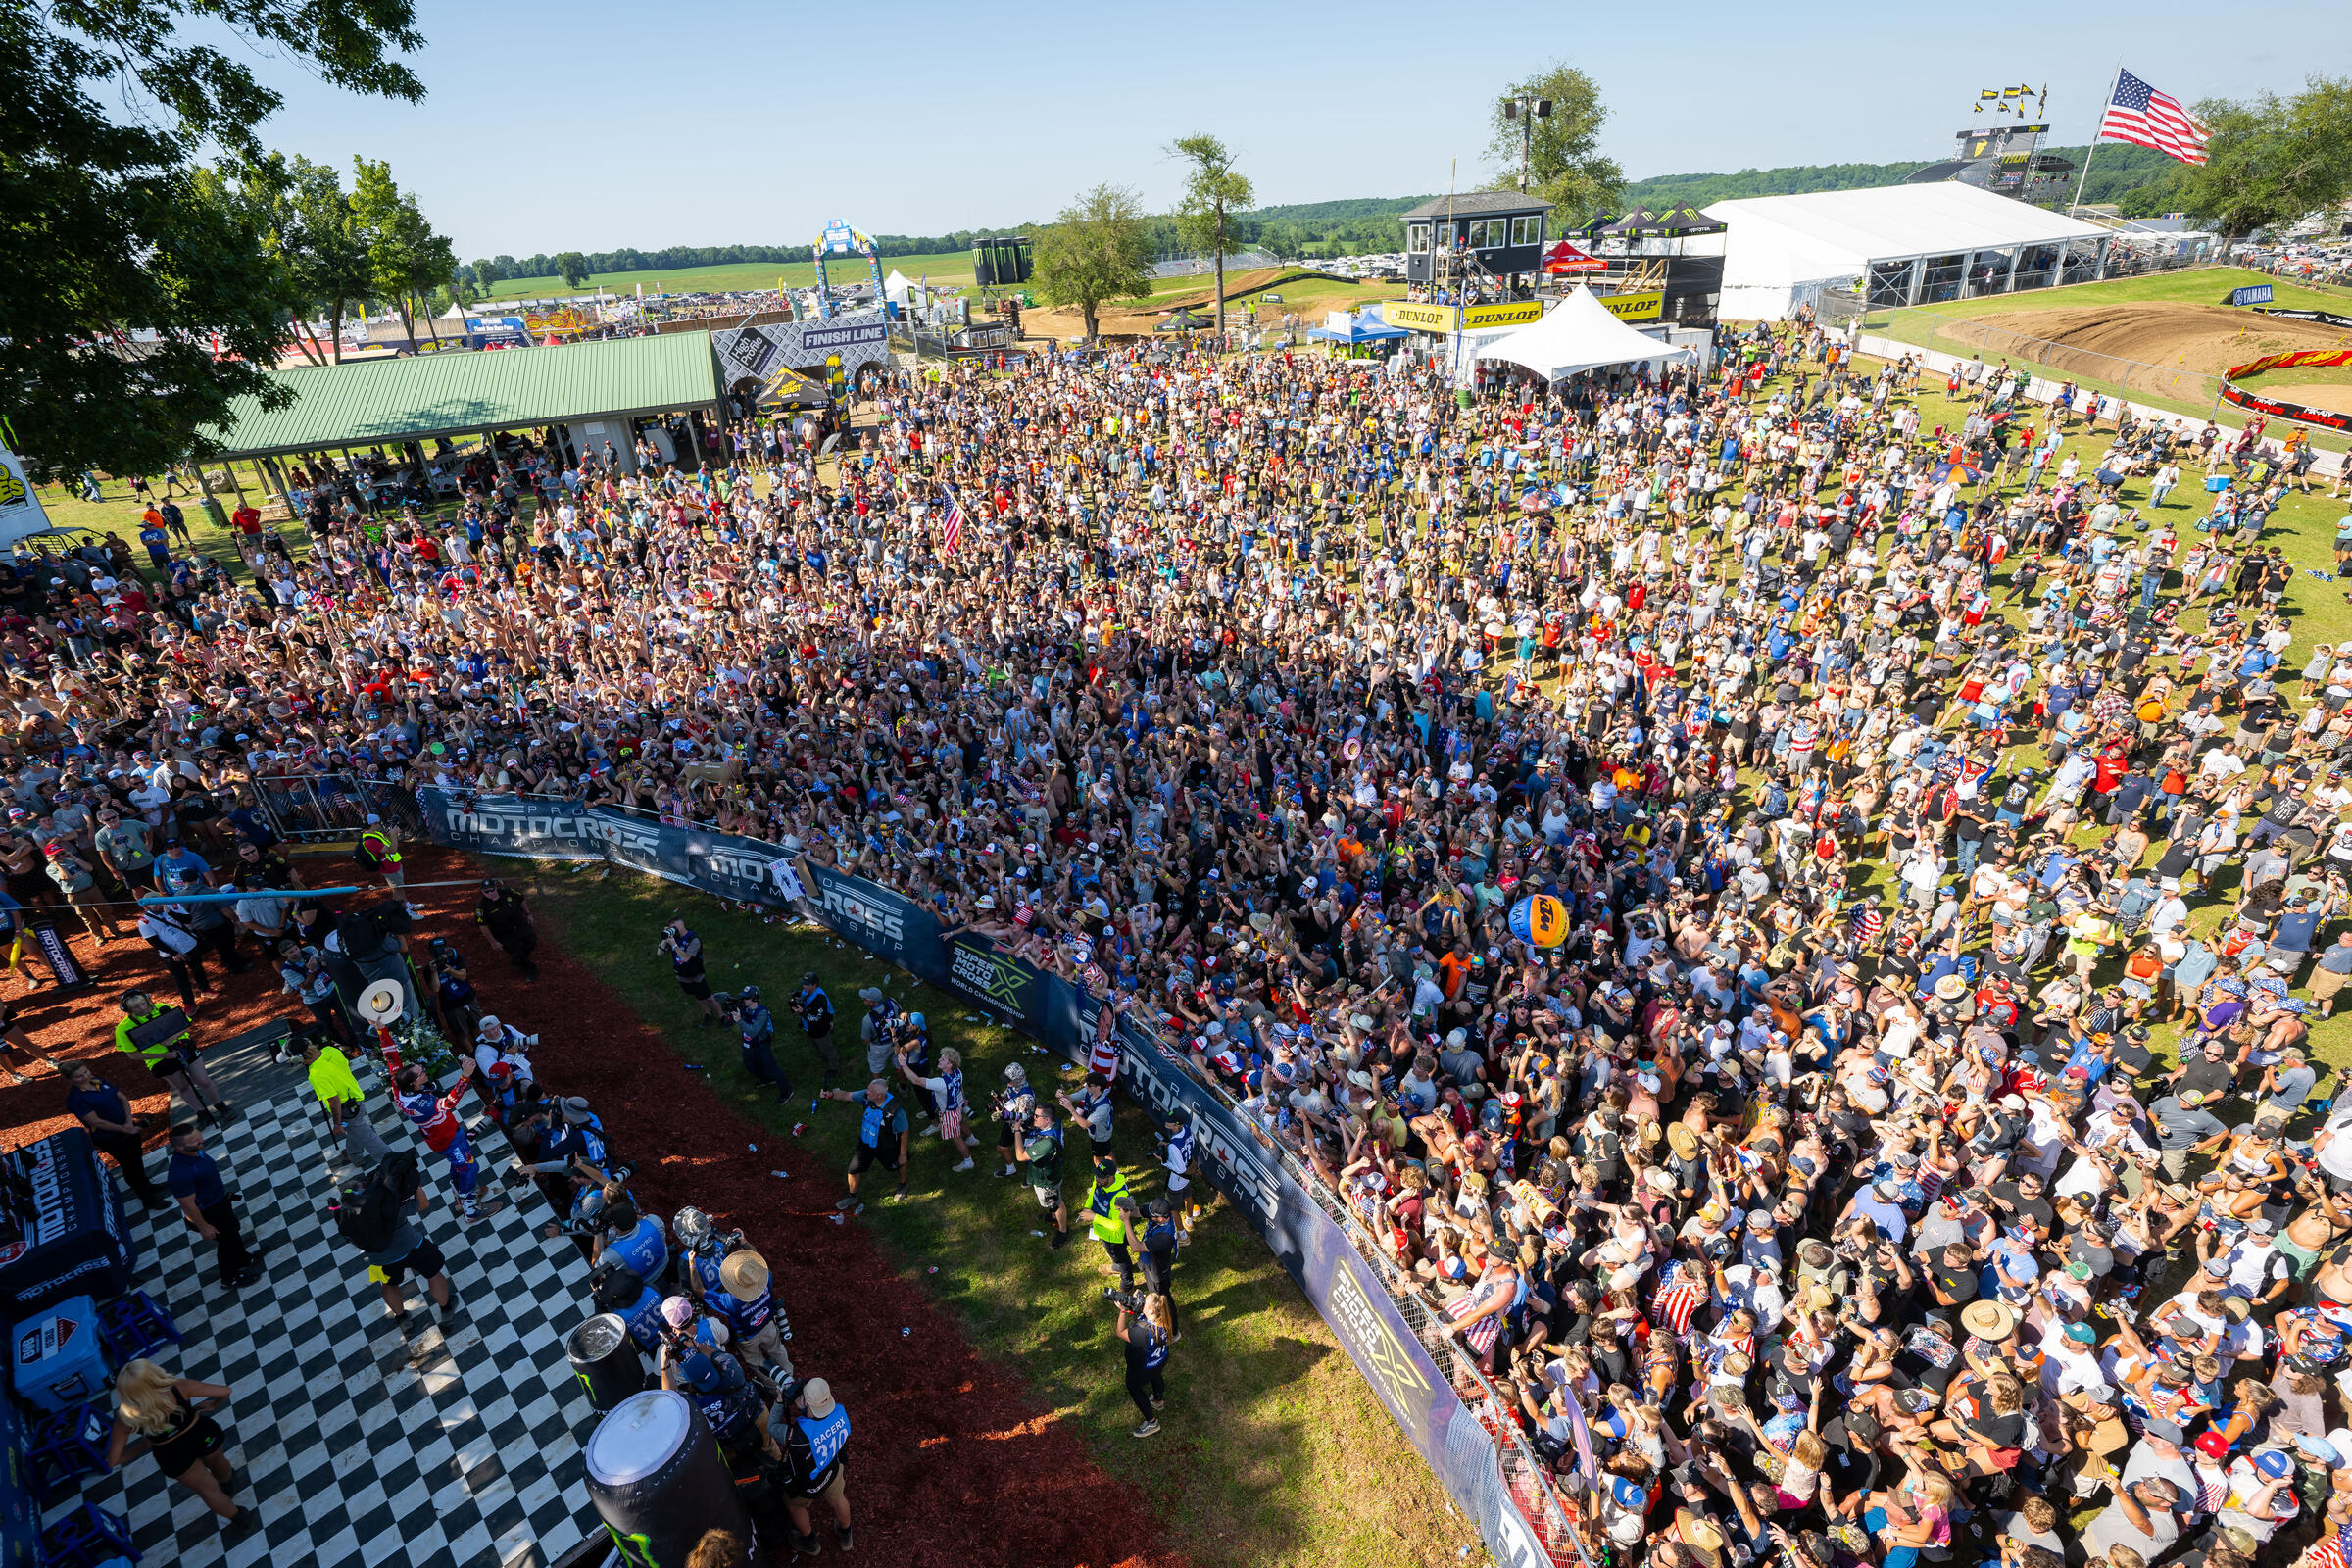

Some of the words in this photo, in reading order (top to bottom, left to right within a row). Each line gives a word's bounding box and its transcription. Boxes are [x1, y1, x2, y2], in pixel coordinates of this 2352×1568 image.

[2243, 286, 2272, 304] YAMAHA
[1398, 310, 1443, 324] DUNLOP
[1471, 310, 1539, 324] DUNLOP
[731, 336, 751, 361] High
[741, 336, 763, 366] Profile
[805, 330, 852, 347] FINISH
[853, 326, 883, 341] LINE
[527, 806, 584, 816] PRO
[451, 832, 660, 863] CHAMPIONSHI
[1538, 896, 1554, 932] KTM
[40, 929, 75, 984] MOTOCROSS
[954, 947, 996, 973] SUPER
[956, 956, 993, 980] MOTO
[952, 964, 992, 990] CROSS
[951, 977, 973, 994] WORLD
[974, 990, 1025, 1020] CHAMPIONSHIP
[24, 1139, 67, 1246] MOTOCROSS
[51, 1134, 78, 1232] CHAMPIONSHIP
[642, 1249, 655, 1267] 3
[15, 1258, 112, 1302] MOTOCROSS
[643, 1295, 660, 1313] MEDIA
[1338, 1268, 1382, 1336] SUPER
[1338, 1284, 1379, 1347] MOTO
[634, 1304, 664, 1340] 319
[1332, 1290, 1376, 1354] CROSS
[1330, 1306, 1356, 1346] WORLD
[1355, 1343, 1417, 1431] CHAMPIONSHIP
[813, 1416, 846, 1446] RACERX
[816, 1428, 849, 1466] 310
